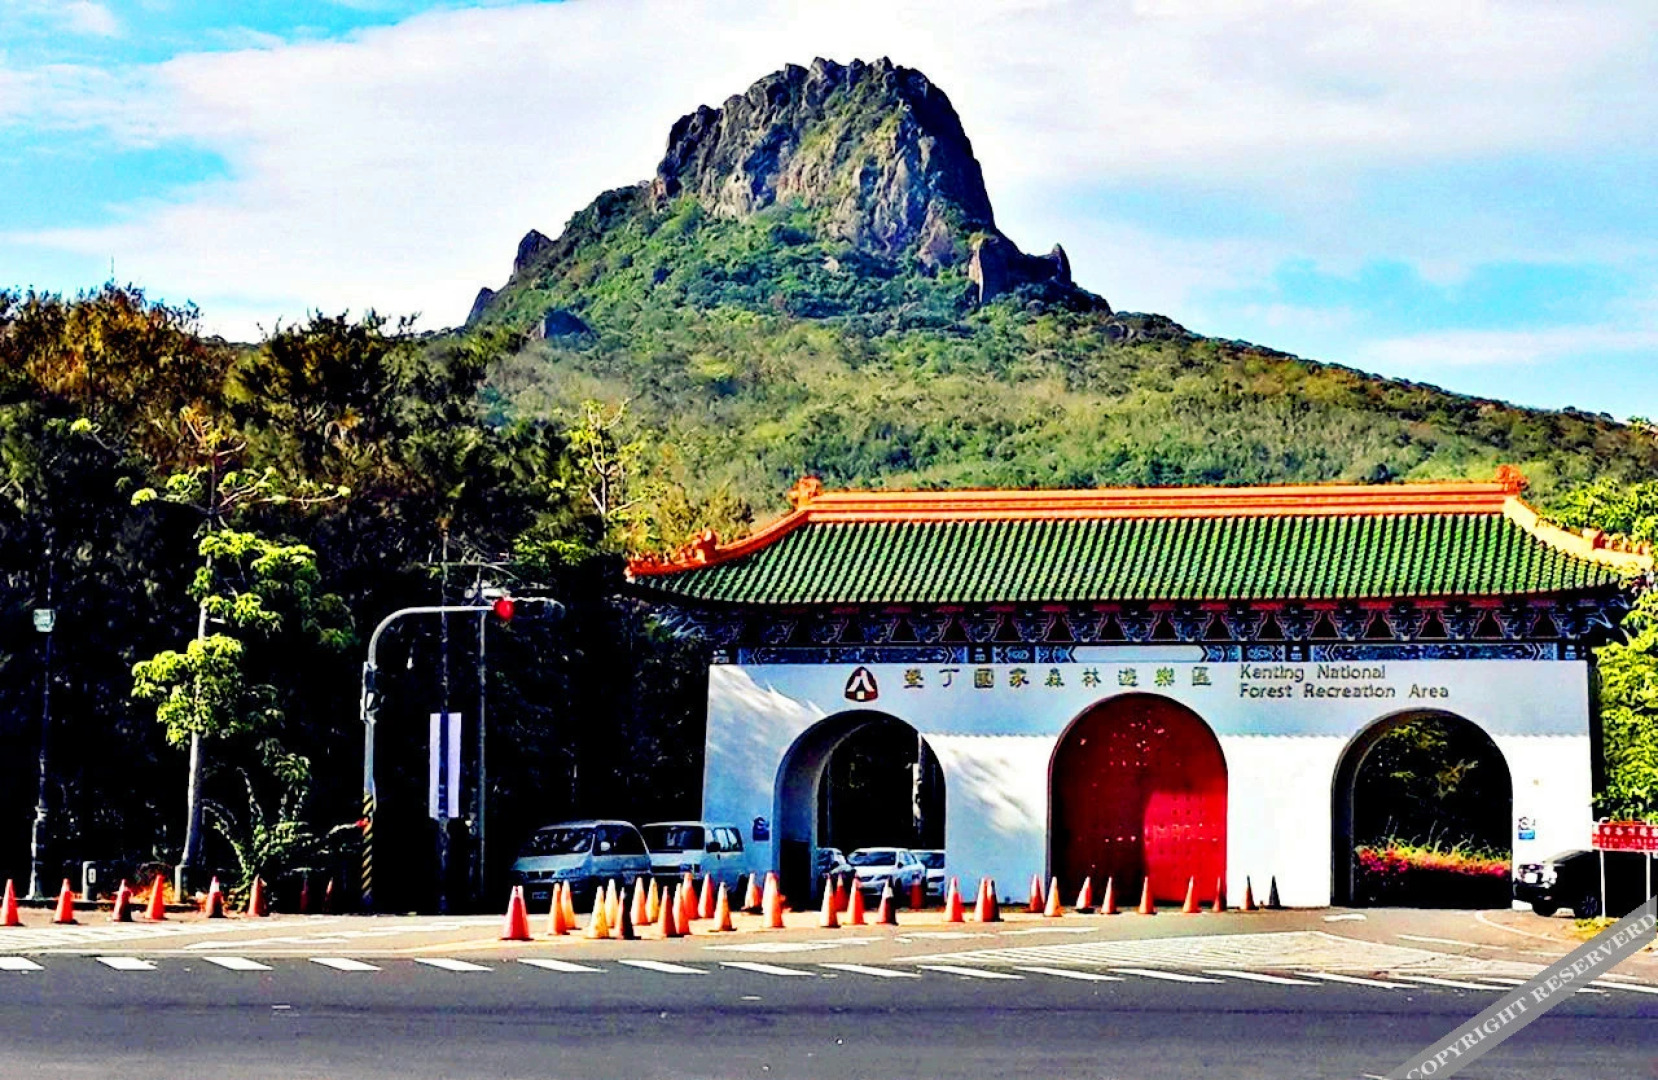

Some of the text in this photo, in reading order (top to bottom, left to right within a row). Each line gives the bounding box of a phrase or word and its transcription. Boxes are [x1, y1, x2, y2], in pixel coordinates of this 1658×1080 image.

[1240, 664, 1386, 683] Kenting National
[1240, 683, 1449, 698] Forest Recreation Area
